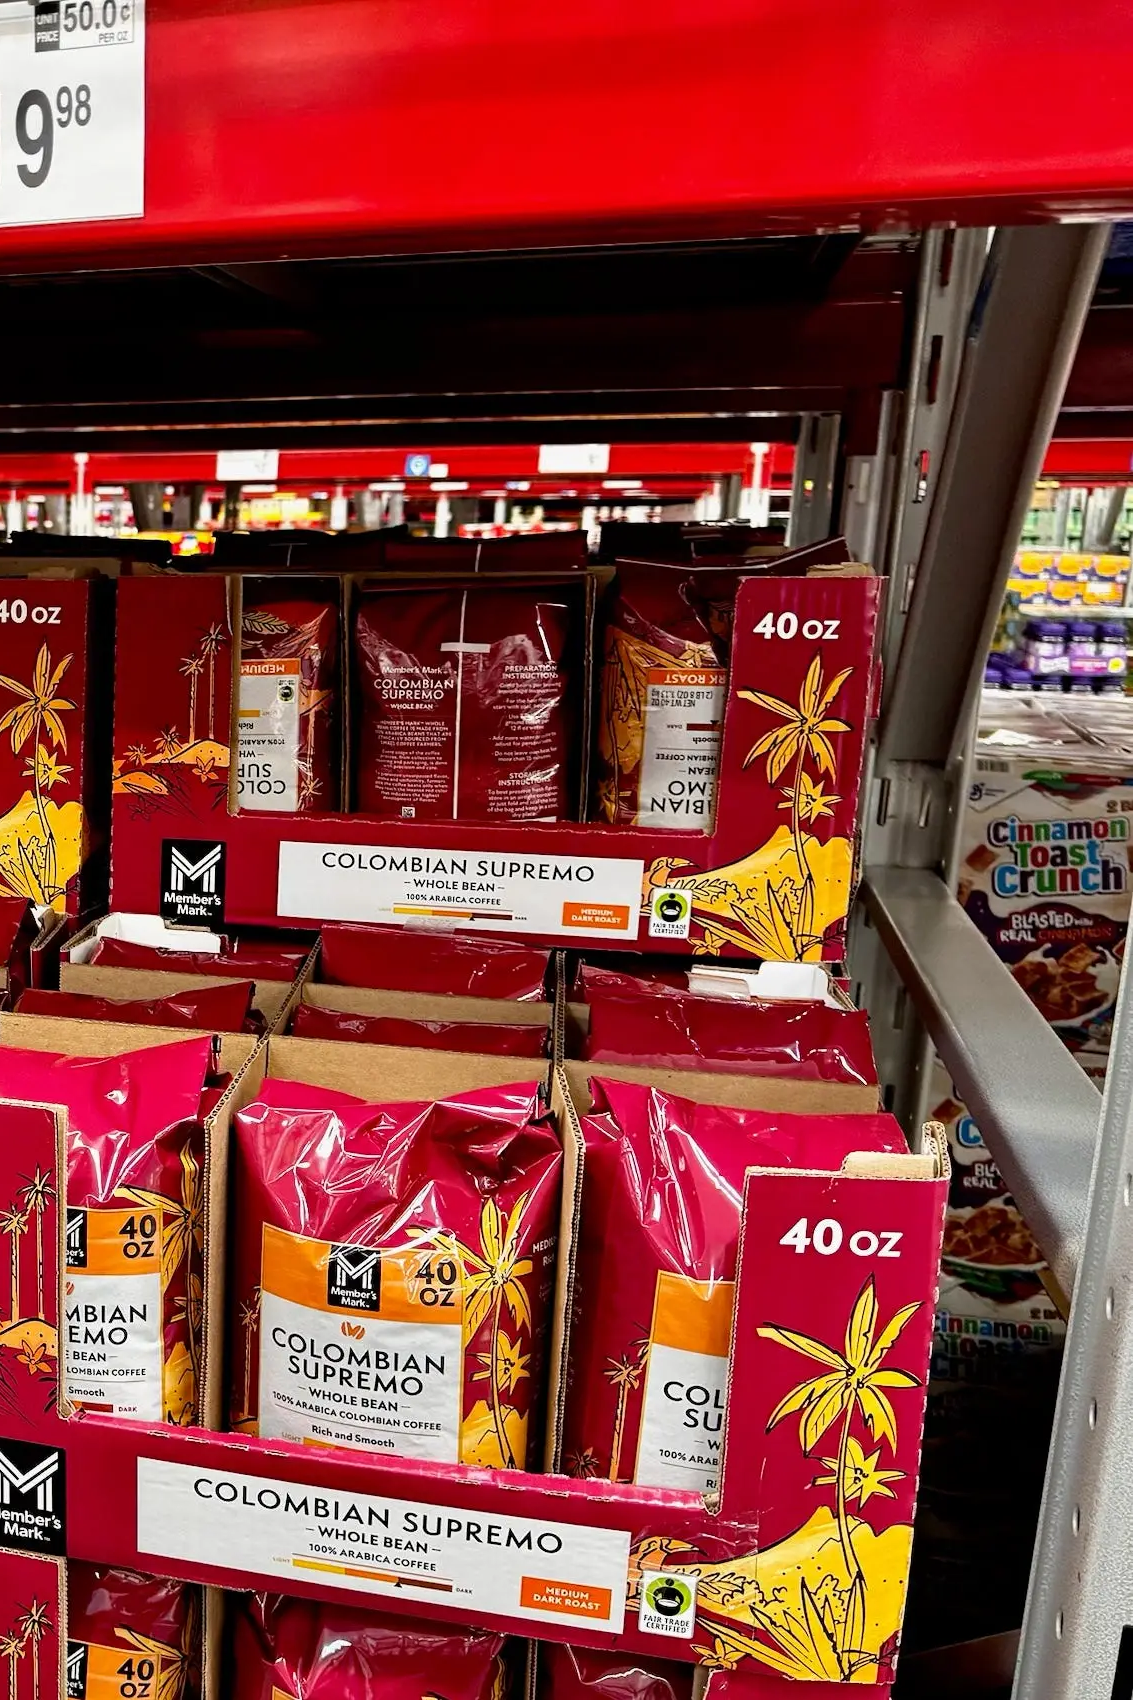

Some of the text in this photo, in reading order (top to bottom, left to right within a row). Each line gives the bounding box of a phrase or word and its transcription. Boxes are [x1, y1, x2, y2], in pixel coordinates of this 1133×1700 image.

[36, 12, 59, 25] UNIT
[36, 31, 59, 43] PRICE
[99, 31, 129, 44] PER OZ
[752, 612, 798, 639] 40
[241, 664, 285, 674] MEDIUM
[422, 667, 443, 675] Mark
[504, 665, 557, 673] PREPARATION
[373, 679, 455, 690] COLOMBIAN
[664, 674, 705, 684] ROAST
[381, 689, 445, 700] SUPREMO
[655, 753, 684, 761] COFFEE
[992, 816, 1127, 843] Cinnamon
[1014, 839, 1101, 868] Toast
[322, 852, 595, 882] COLOMBIAN SUPREMO
[994, 859, 1124, 895] Crunch
[413, 878, 496, 892] WHOLE BEAN
[163, 892, 222, 906] Member's
[176, 904, 208, 916] Mark
[1011, 911, 1074, 930] BLASTED
[999, 928, 1036, 942] REAL
[119, 1215, 157, 1240] 40
[779, 1217, 843, 1255] 40
[123, 1241, 155, 1259] OZ
[417, 1260, 457, 1285] 40
[331, 1286, 377, 1300] Member's
[419, 1288, 455, 1307] OZ
[341, 1296, 366, 1307] Mark
[72, 1350, 107, 1362] BEAN
[271, 1327, 445, 1375] COLOMBIAN
[111, 1368, 146, 1376] COFFEE
[288, 1355, 423, 1396] SUPREMO
[68, 1386, 105, 1397] Smooth
[308, 1386, 398, 1412] WHOLE BEAN
[272, 1391, 442, 1431] 100% ARABICA COLOMBIAN COFFEE
[312, 1424, 395, 1448] Rich and Smooth
[659, 1449, 687, 1461] 100%
[193, 1478, 563, 1554] COLOMBIAN SUPREMO
[4, 1521, 44, 1541] Mark
[318, 1525, 428, 1554] WHOLE BEAN
[308, 1543, 437, 1572] 100% ARABICA COFFEE
[545, 1586, 590, 1600] MEDIUM
[533, 1593, 601, 1611] DARK ROAST
[643, 1614, 690, 1628] FAIR TRADE
[646, 1622, 686, 1634] CERTIFIED
[117, 1658, 155, 1681] 40
